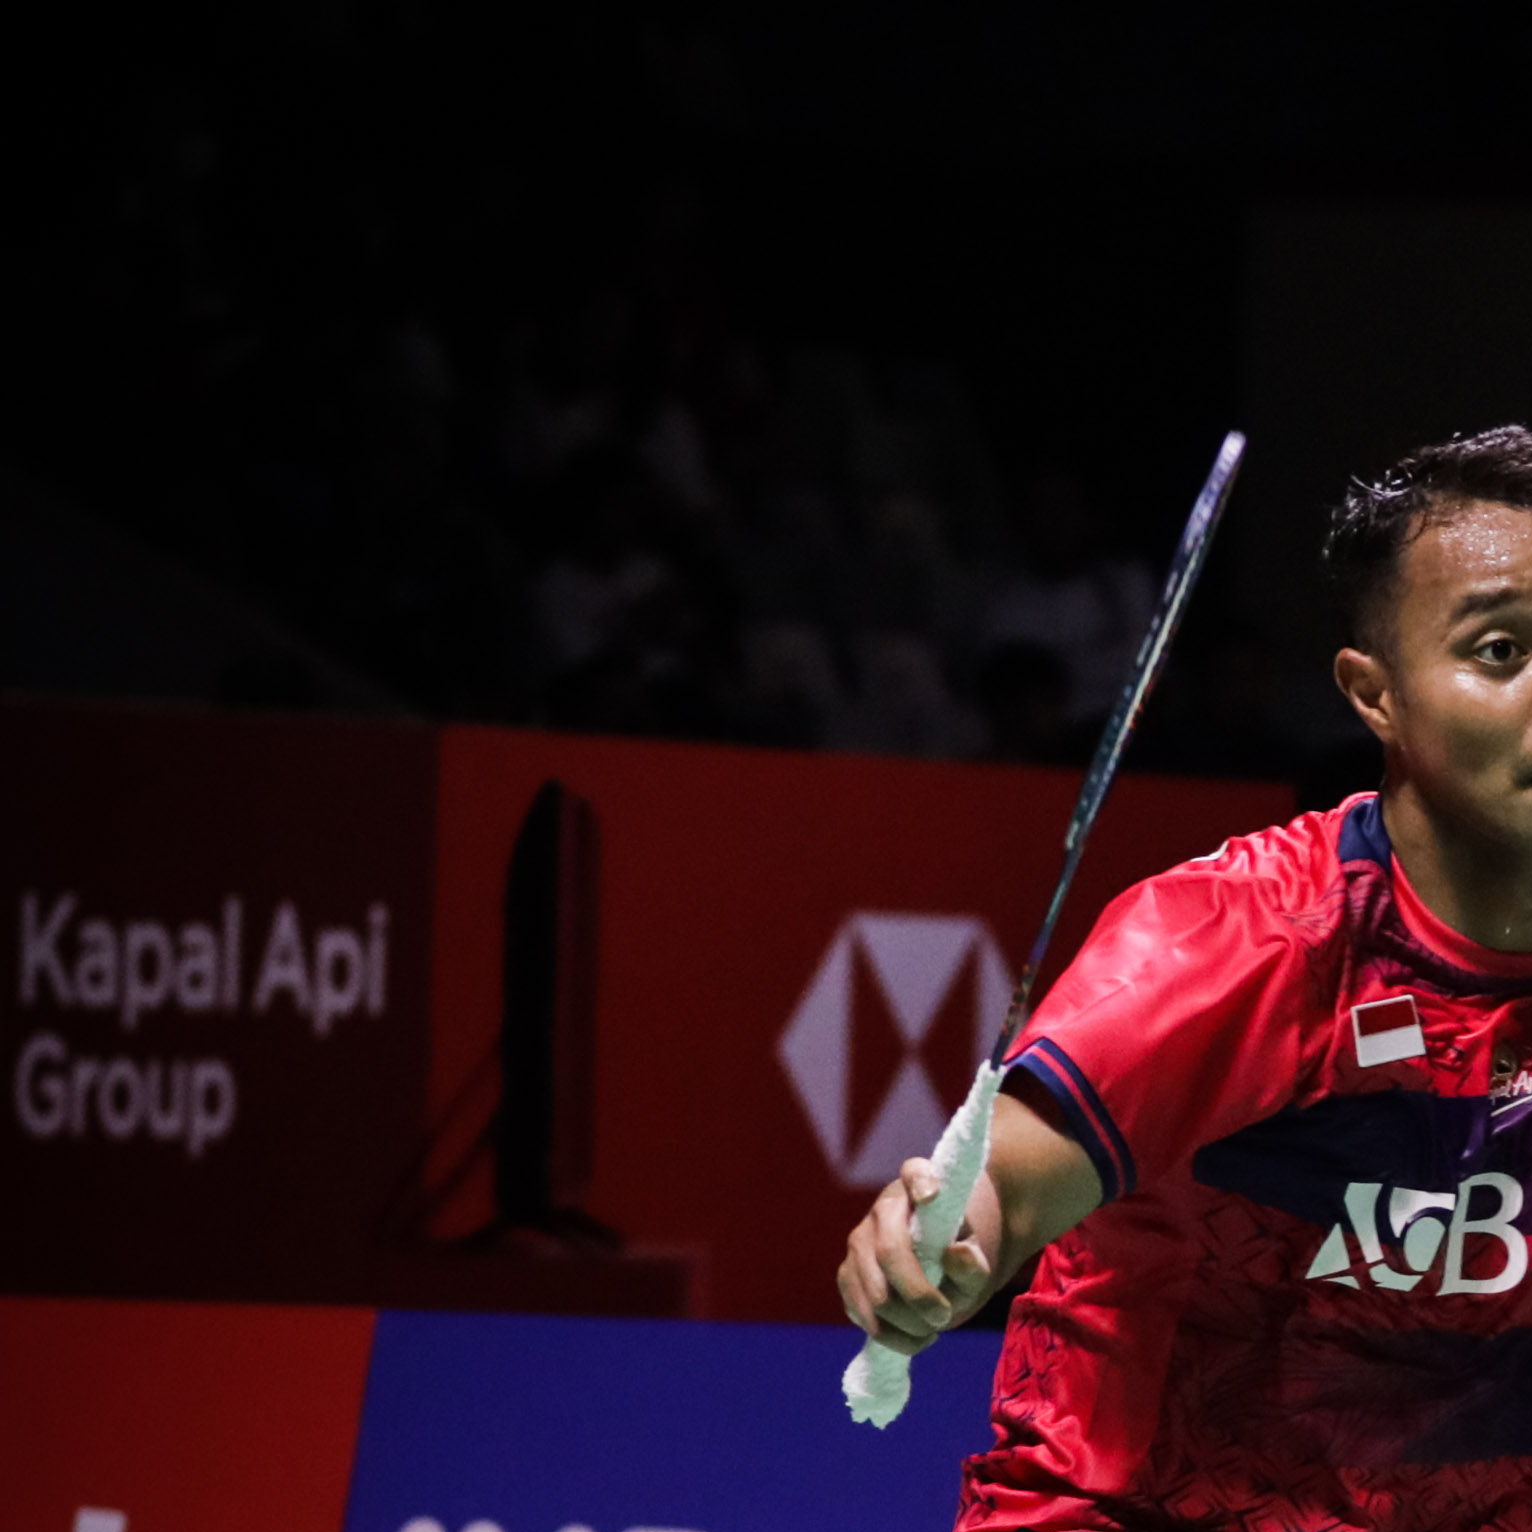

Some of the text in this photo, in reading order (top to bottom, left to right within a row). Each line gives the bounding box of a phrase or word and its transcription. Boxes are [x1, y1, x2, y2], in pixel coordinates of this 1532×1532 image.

[19, 888, 391, 1043] Kapal Api
[13, 1027, 239, 1161] Group
